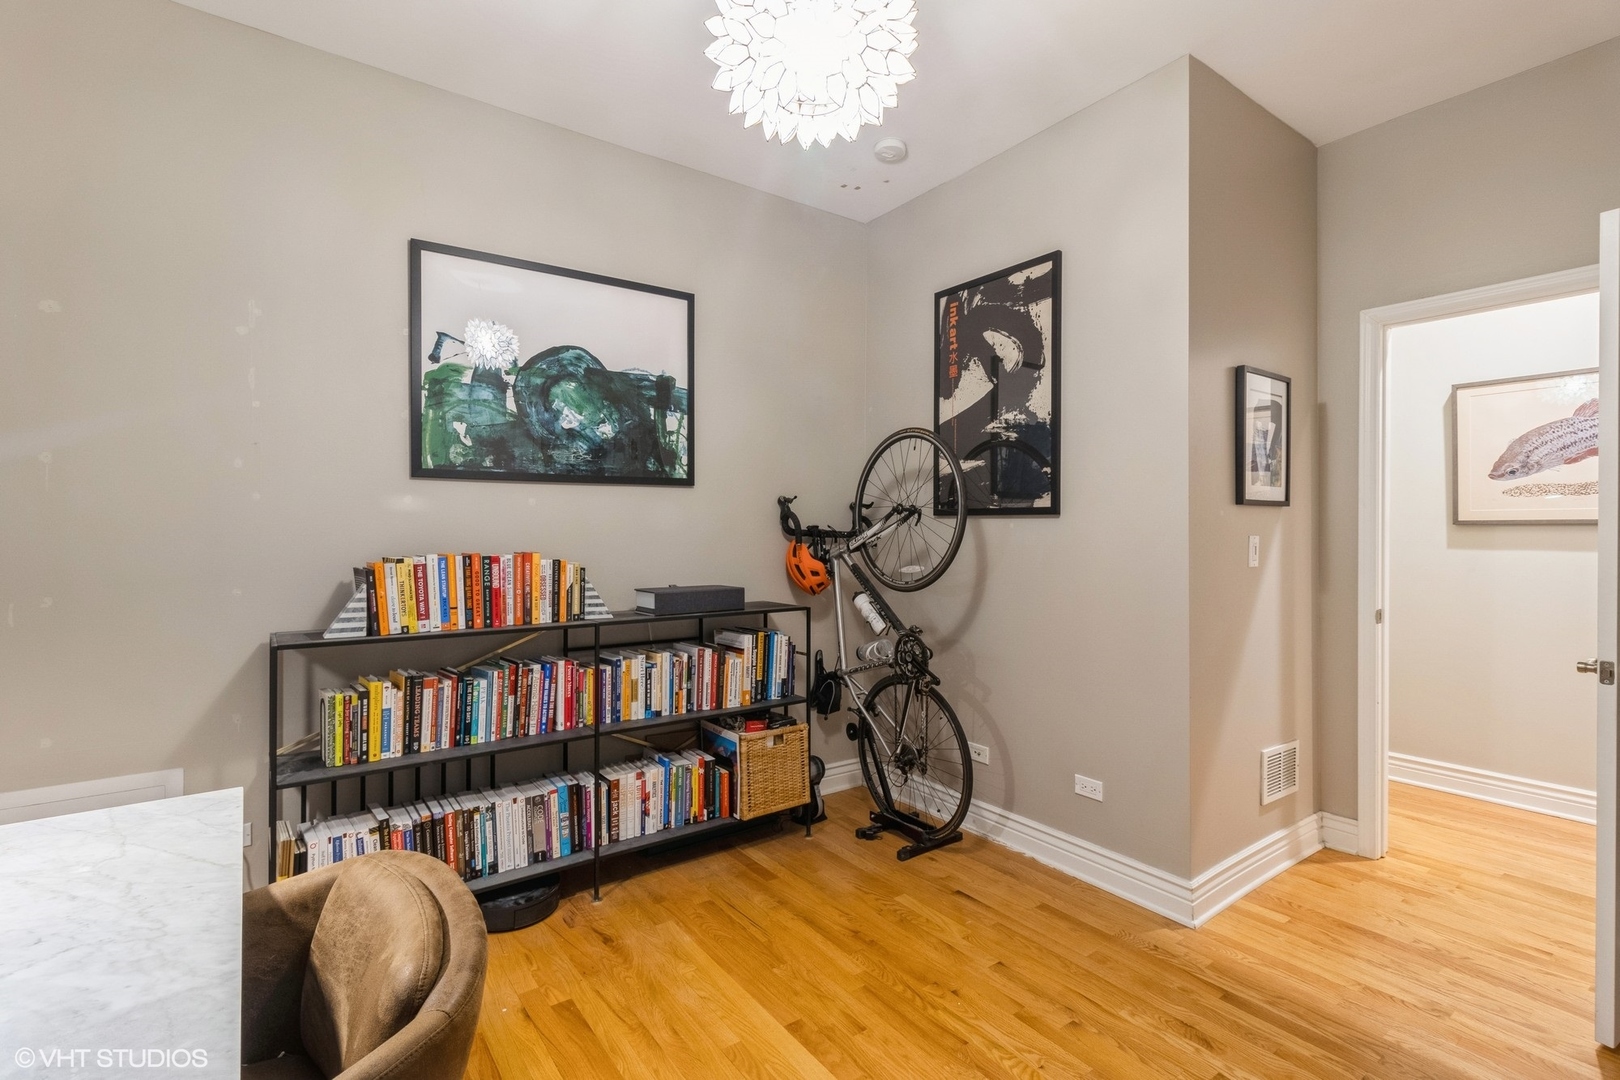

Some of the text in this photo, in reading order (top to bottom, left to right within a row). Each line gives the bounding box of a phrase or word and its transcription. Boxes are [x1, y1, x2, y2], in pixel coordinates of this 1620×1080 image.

[950, 302, 958, 350] ink art
[399, 581, 407, 617] THINKERTOYS
